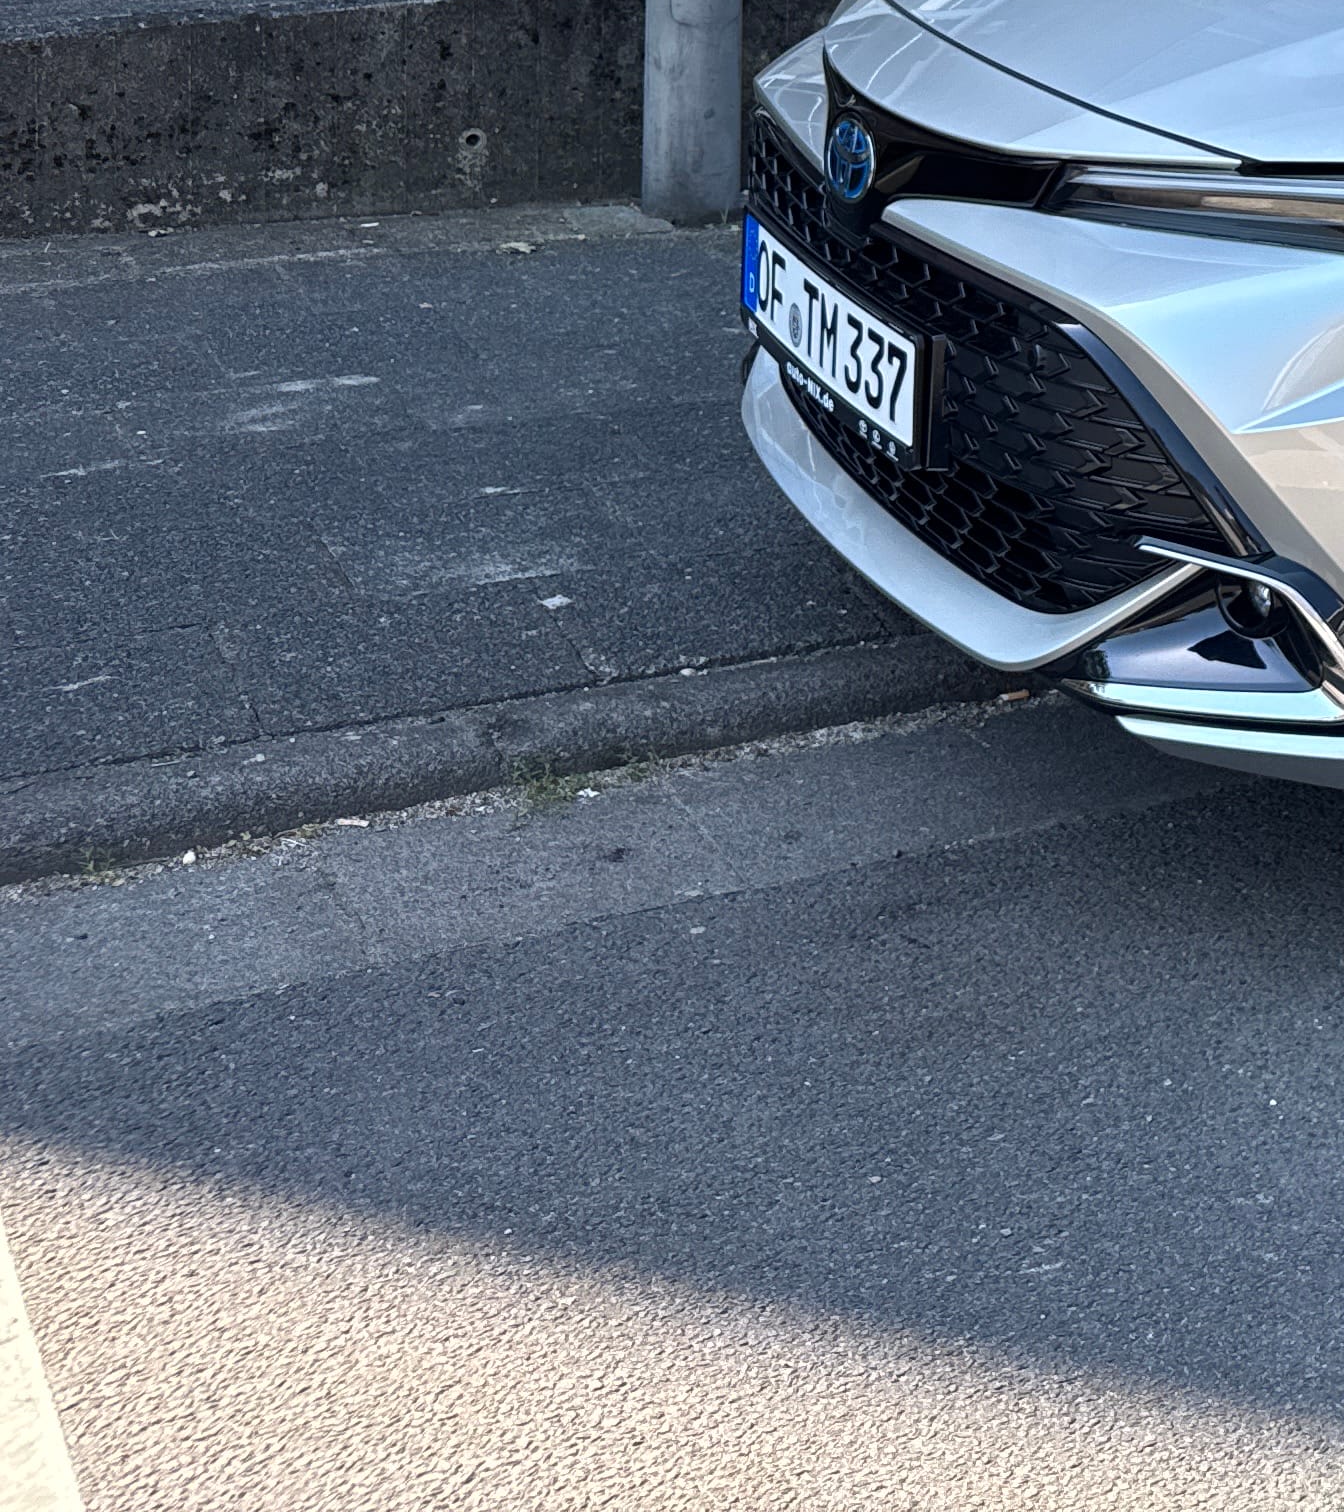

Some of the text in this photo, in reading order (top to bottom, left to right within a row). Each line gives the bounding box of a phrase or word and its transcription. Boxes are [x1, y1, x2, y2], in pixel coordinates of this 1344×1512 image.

[749, 272, 755, 292] D
[757, 239, 787, 321] OF
[803, 278, 839, 378] TM
[844, 313, 907, 423] 337
